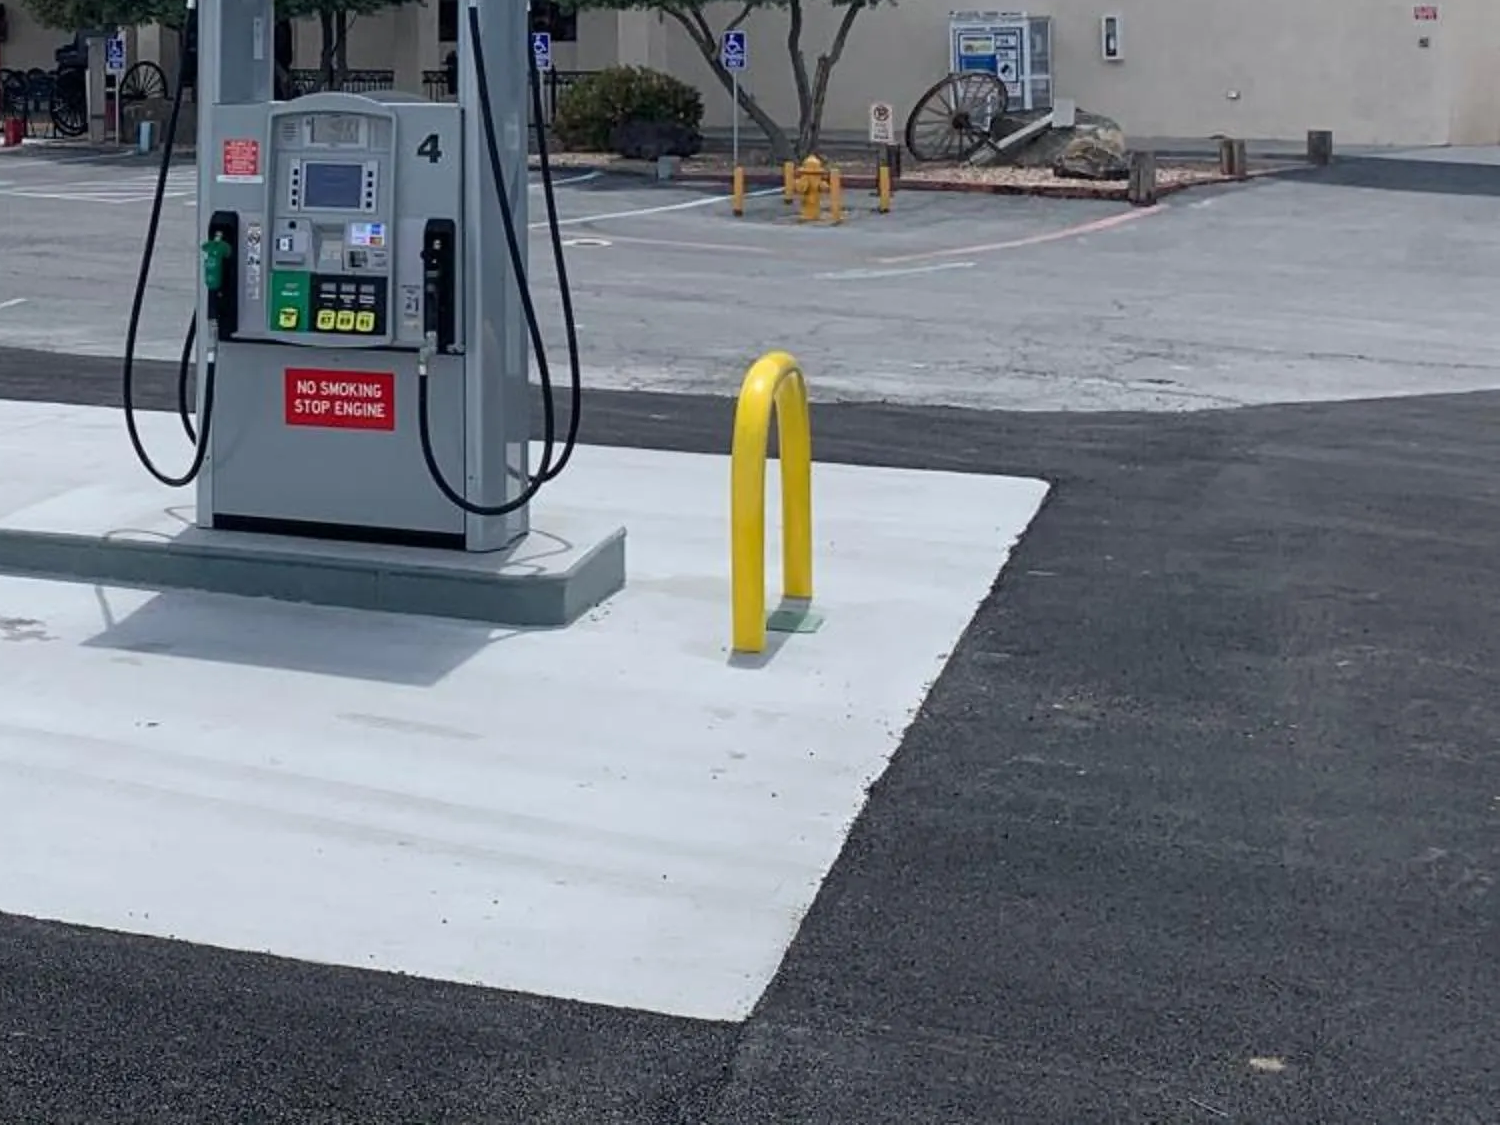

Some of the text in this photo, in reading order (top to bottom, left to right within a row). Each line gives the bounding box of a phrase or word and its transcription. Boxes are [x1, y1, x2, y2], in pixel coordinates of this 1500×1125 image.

[418, 134, 442, 163] 4
[297, 380, 382, 398] NO SMOKING
[294, 398, 386, 418] STOP ENGINE
